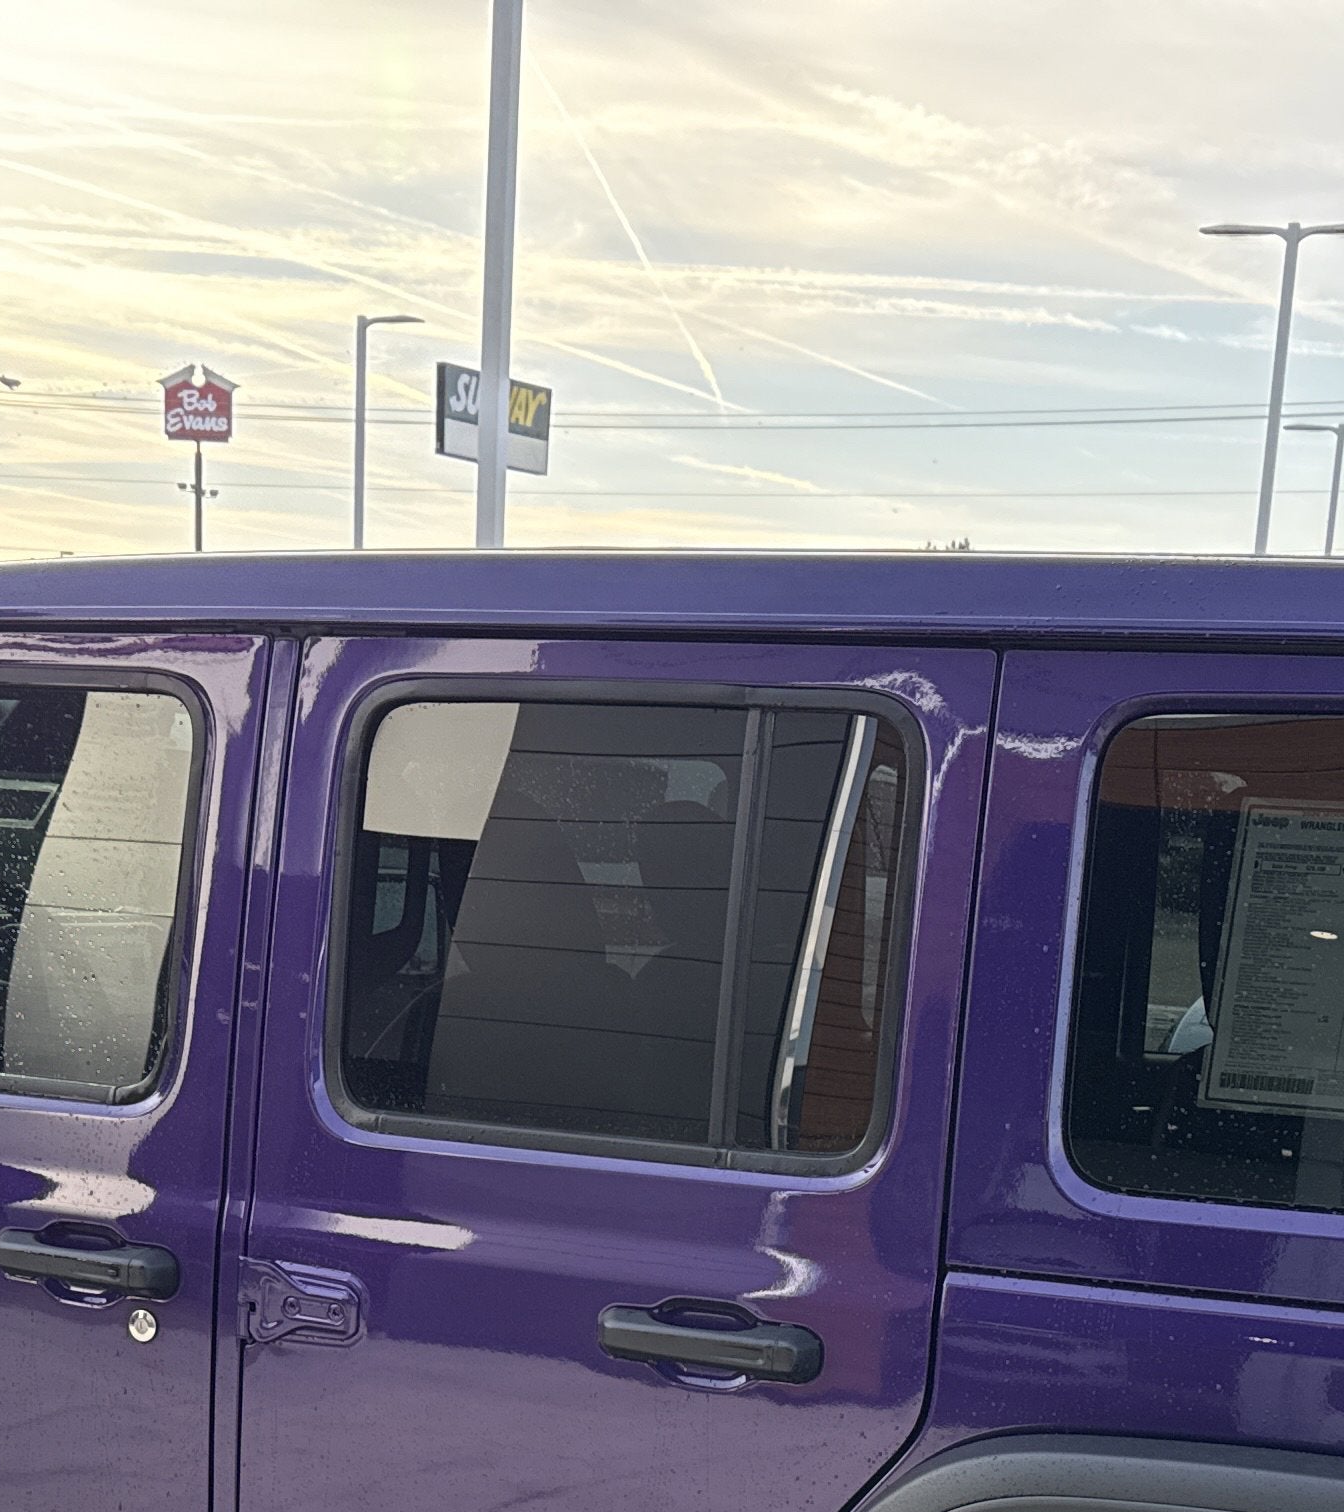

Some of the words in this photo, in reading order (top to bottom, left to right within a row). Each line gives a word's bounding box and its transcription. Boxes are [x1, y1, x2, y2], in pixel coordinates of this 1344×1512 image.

[177, 389, 218, 412] Bob
[449, 373, 548, 427] SUAY
[166, 408, 229, 432] Evans
[1252, 814, 1290, 829] Jeep
